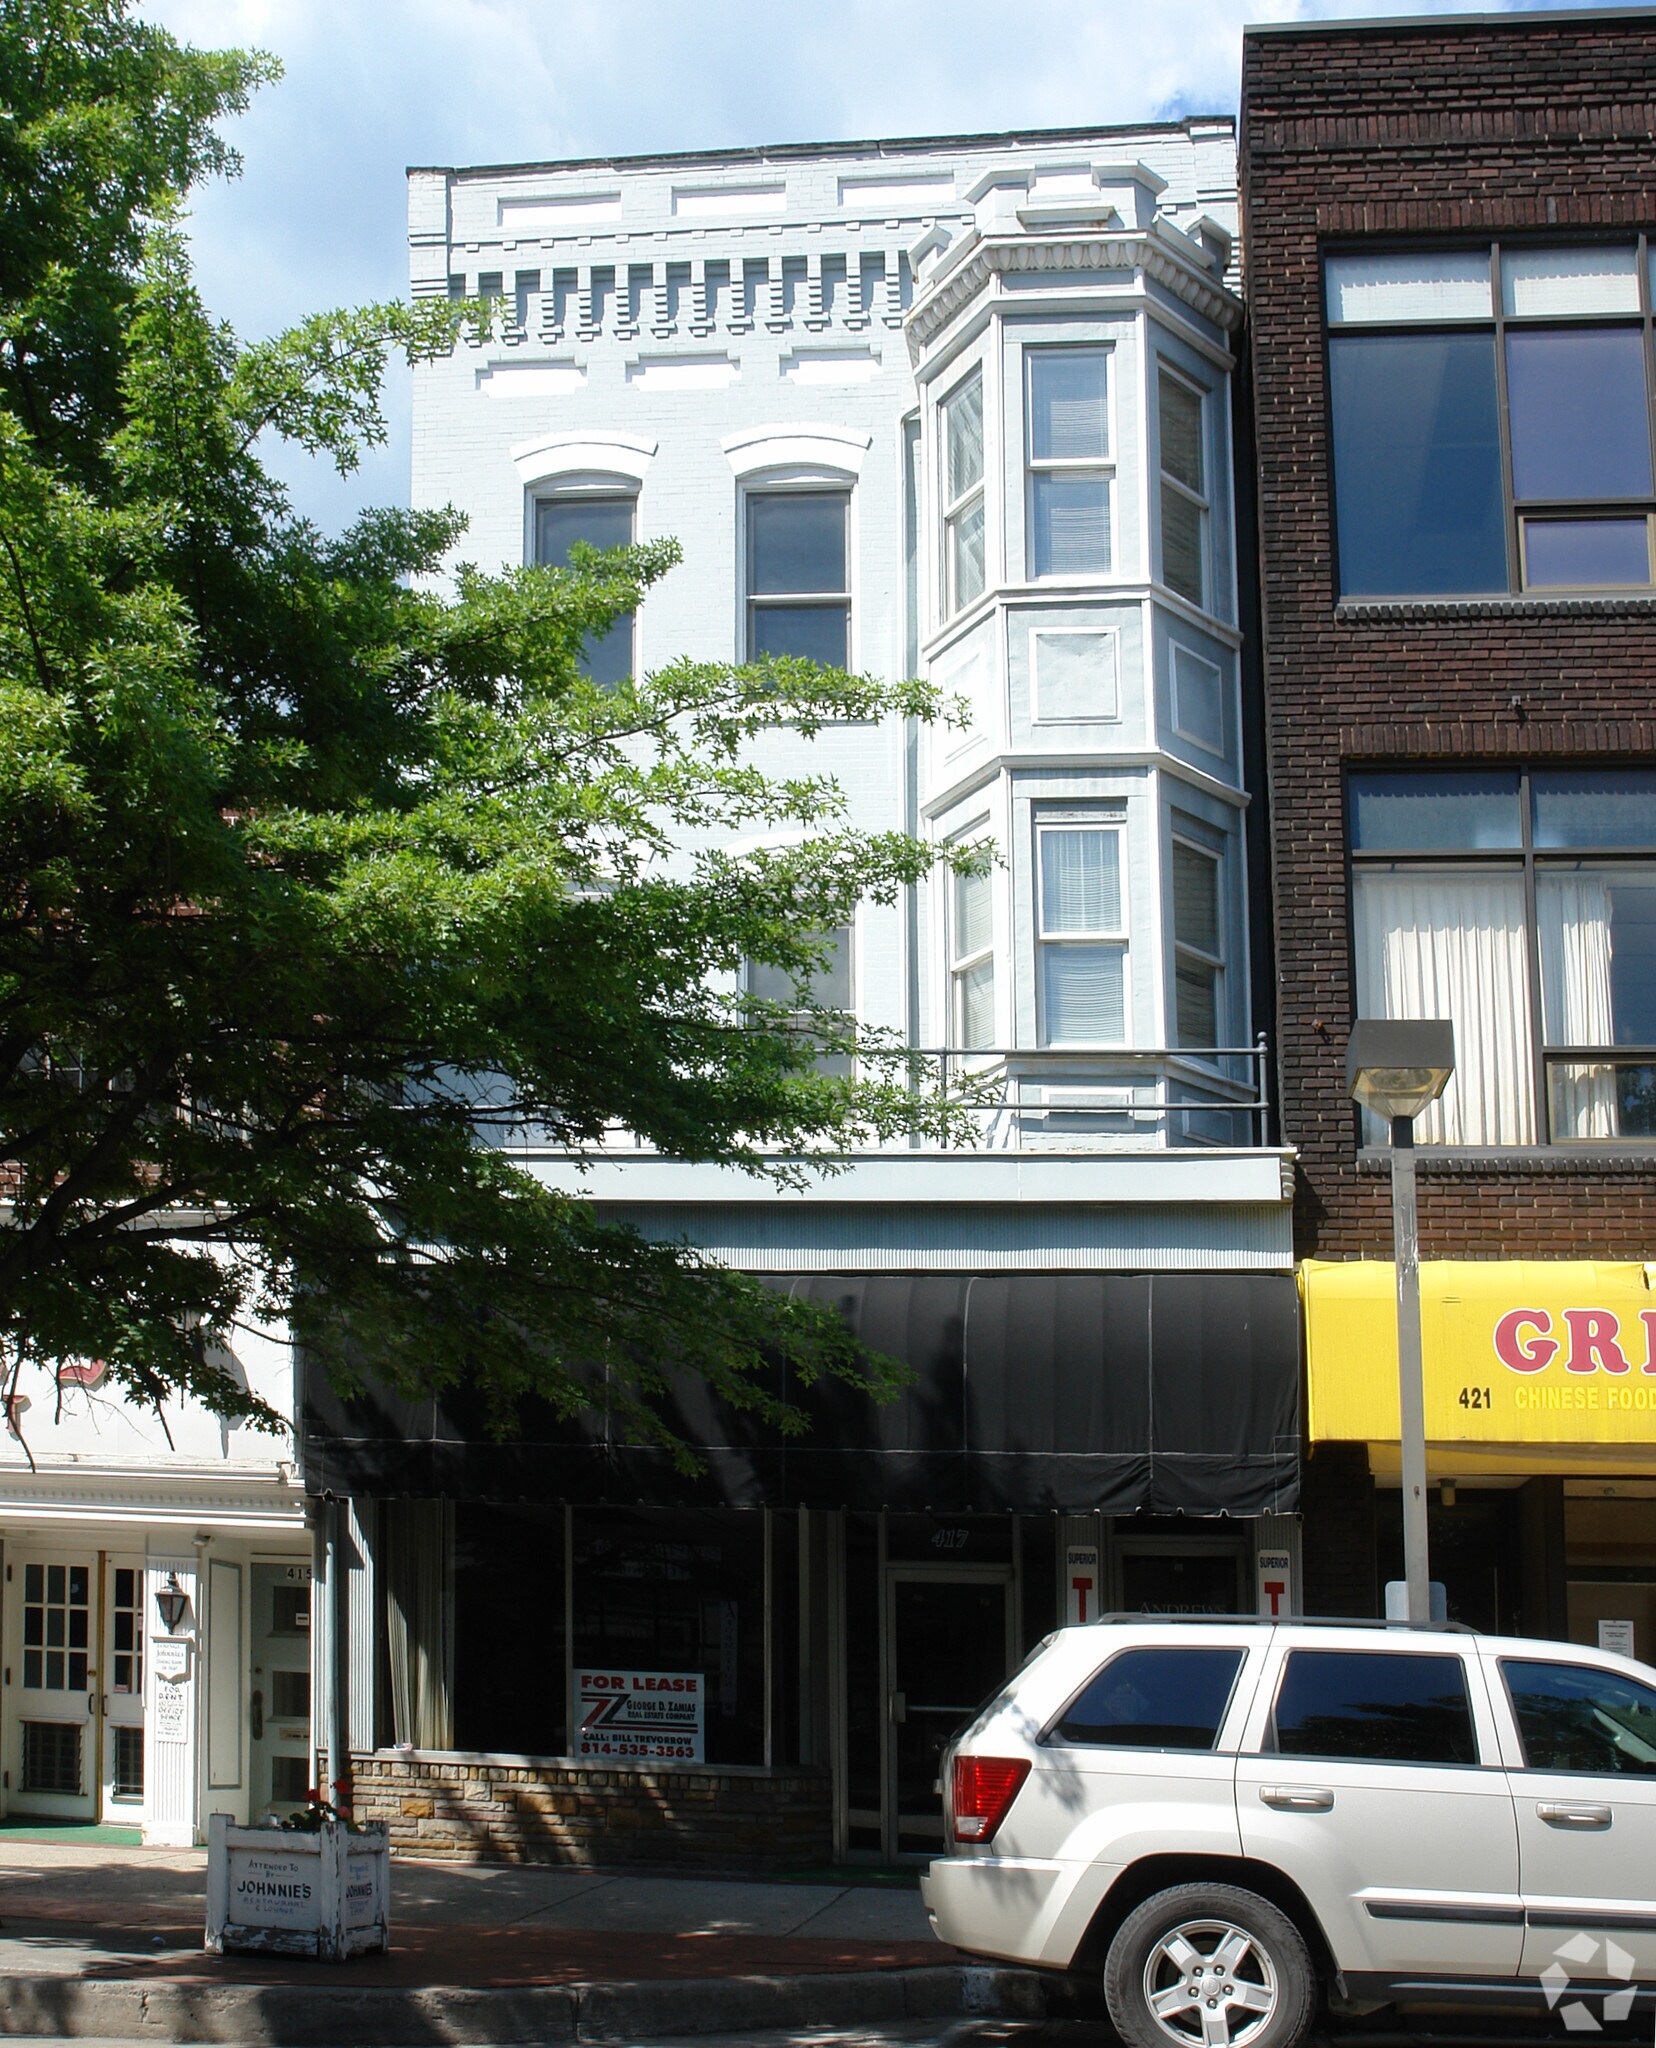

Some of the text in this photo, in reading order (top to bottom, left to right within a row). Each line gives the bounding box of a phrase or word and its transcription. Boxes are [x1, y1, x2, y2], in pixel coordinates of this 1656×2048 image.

[1459, 1387, 1491, 1410] 421
[1515, 1386, 1599, 1410] CHINESE
[931, 1526, 969, 1548] 417
[1067, 1552, 1097, 1565] SUPERIOR
[1260, 1557, 1289, 1569] SUPERIOR
[288, 1568, 312, 1580] 415
[581, 1675, 697, 1693] FOR LEASE
[158, 1692, 183, 1701] RENT
[658, 1700, 666, 1711] D.
[665, 1712, 695, 1721] COMPANY
[583, 1733, 692, 1745] CALL: BILL TREVORROW
[581, 1742, 695, 1758] 814-535-3563
[237, 1880, 312, 1899] JOHNNIE'S
